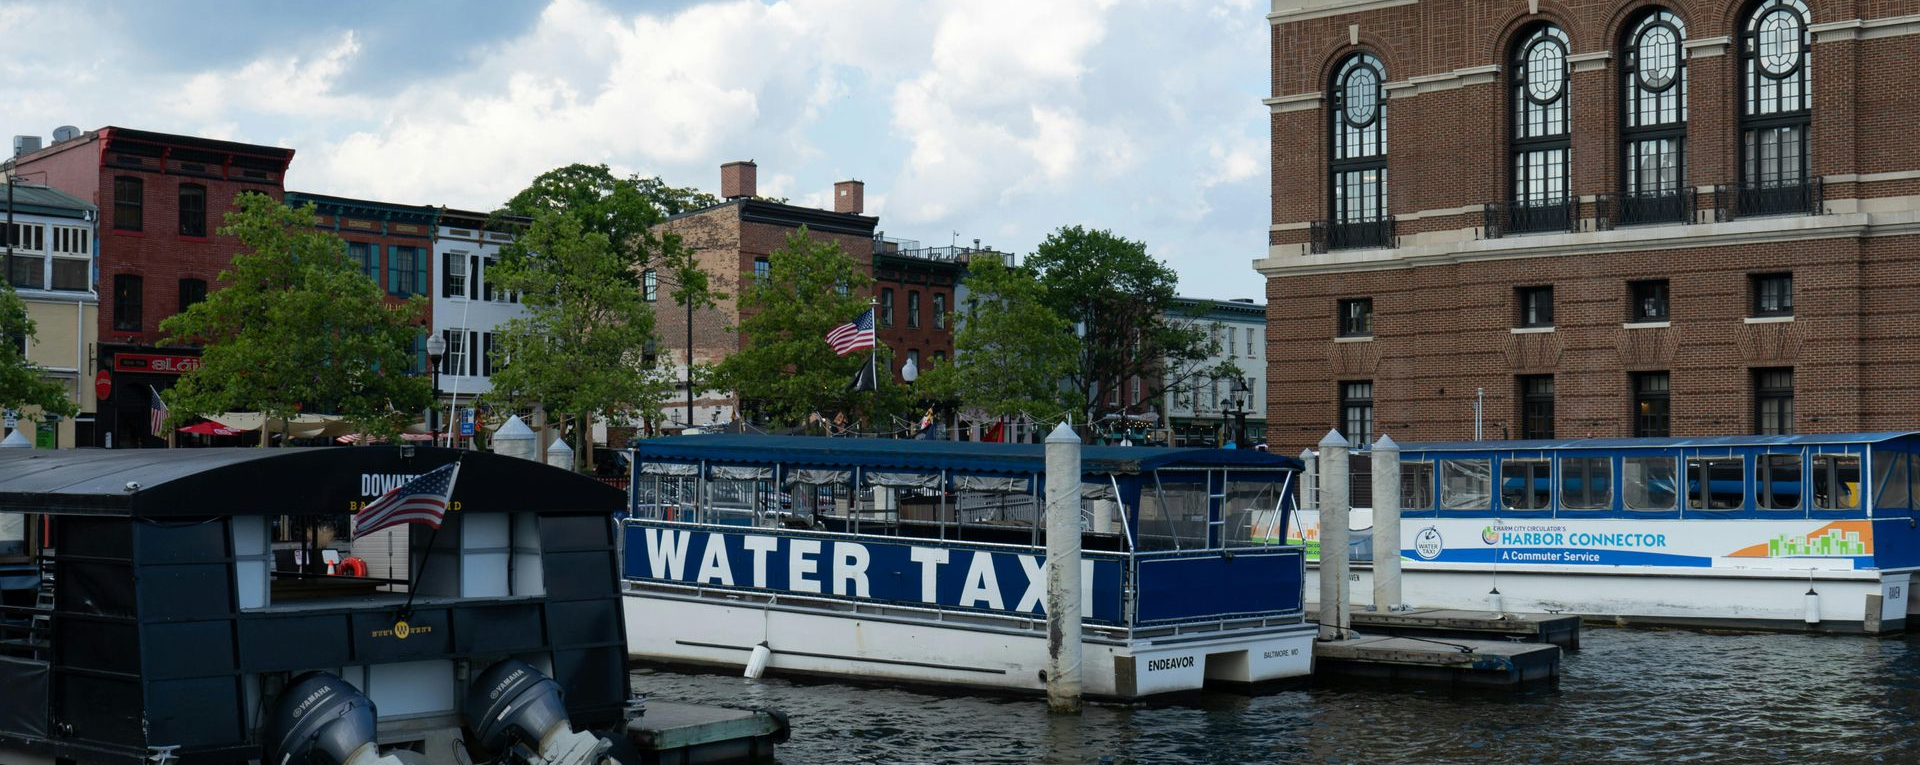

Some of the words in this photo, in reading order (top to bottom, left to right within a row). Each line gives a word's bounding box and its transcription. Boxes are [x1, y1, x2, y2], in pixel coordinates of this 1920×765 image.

[1502, 532, 1564, 546] HARBOR
[1569, 533, 1666, 547] CONNECTOR
[1502, 551, 1509, 560] A
[1511, 551, 1561, 561] Commuter
[1563, 552, 1600, 562] Service
[645, 528, 872, 598] WATER
[910, 546, 1095, 618] TAXI
[1148, 656, 1194, 672] ENDEAVOR
[495, 669, 525, 692] YAMAHA
[299, 685, 332, 710] YAMAHA
